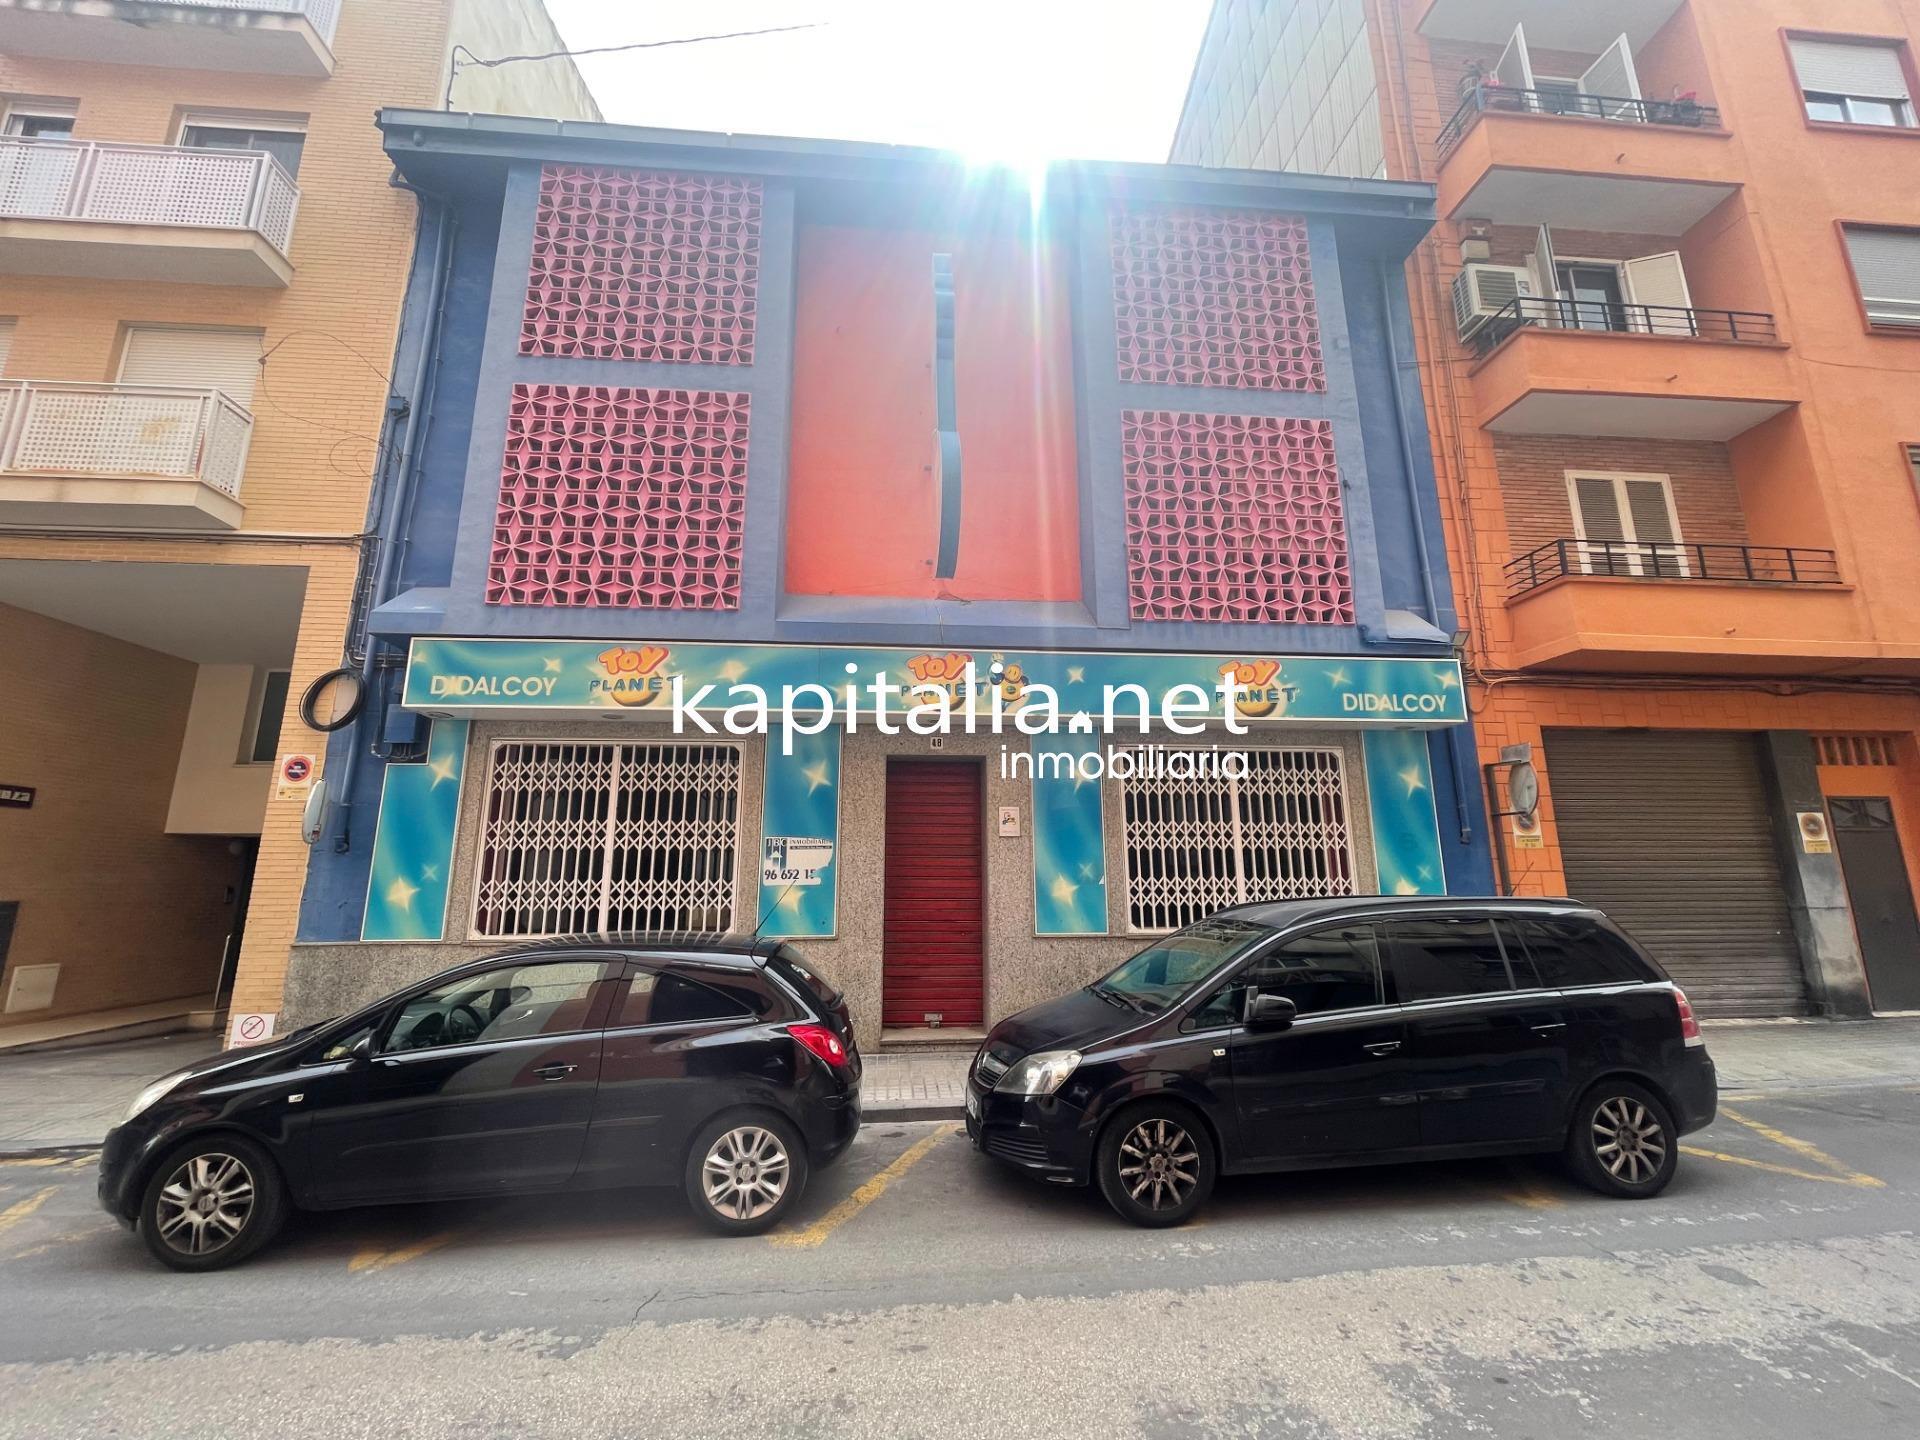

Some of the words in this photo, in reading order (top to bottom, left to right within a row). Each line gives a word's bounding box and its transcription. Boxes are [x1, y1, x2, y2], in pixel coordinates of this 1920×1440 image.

[599, 646, 669, 675] TOY
[907, 653, 973, 680] TOY
[1218, 661, 1281, 685] TOY
[430, 675, 558, 697] DIDALCOY
[1215, 687, 1298, 703] PANET
[1343, 692, 1447, 712] DIDALCOY
[764, 869, 777, 880] 96
[781, 869, 800, 880] 652
